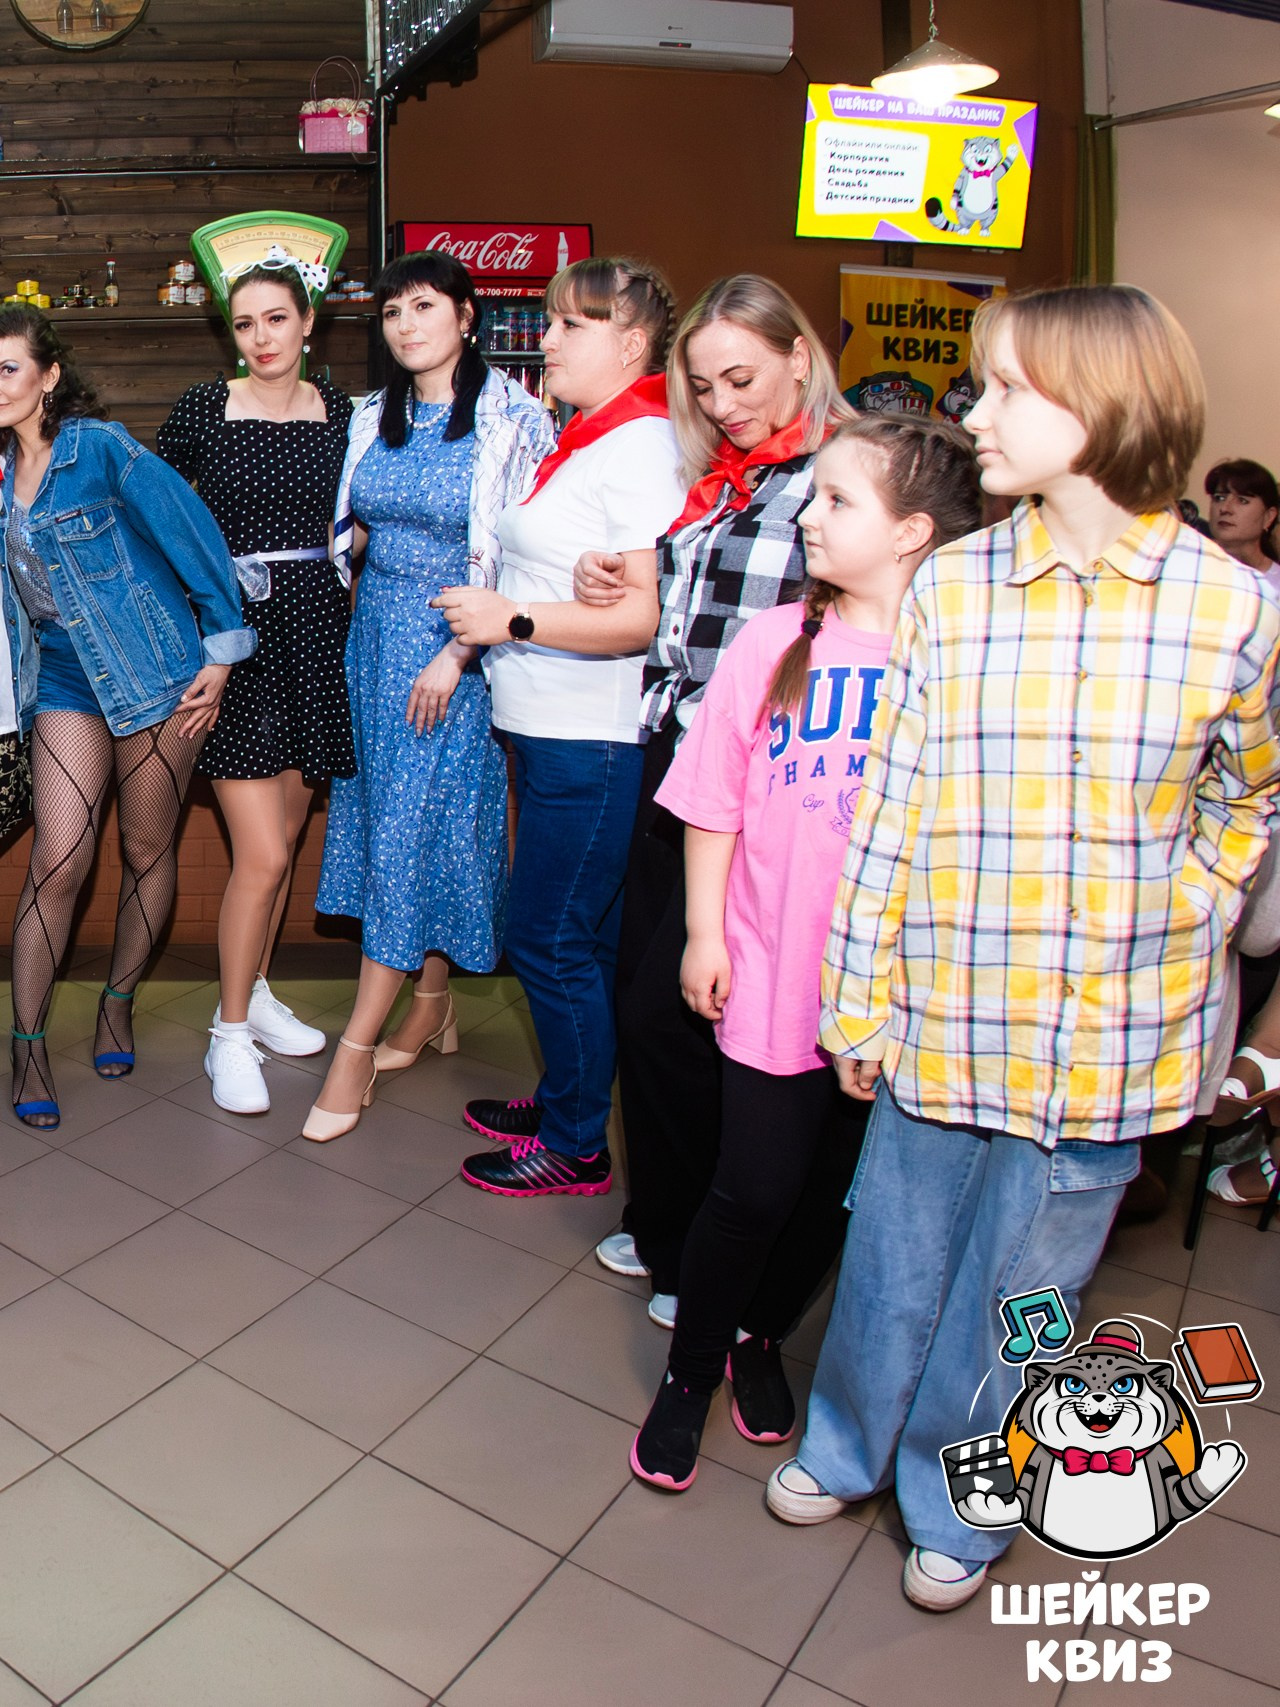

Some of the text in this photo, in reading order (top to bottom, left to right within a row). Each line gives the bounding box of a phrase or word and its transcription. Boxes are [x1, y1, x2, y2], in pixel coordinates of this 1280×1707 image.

[833, 96, 1001, 122] ШЕЙКЕР НА ВАШ ПРАЗДНИК
[829, 151, 889, 163] Корпоратив
[828, 165, 905, 177] День рождения
[827, 178, 869, 188] Свадьба
[825, 191, 915, 205] Детский праздник
[425, 231, 540, 271] Coca-Cola
[474, 287, 522, 297] 00-700-7777
[883, 335, 960, 366] КВИЗ
